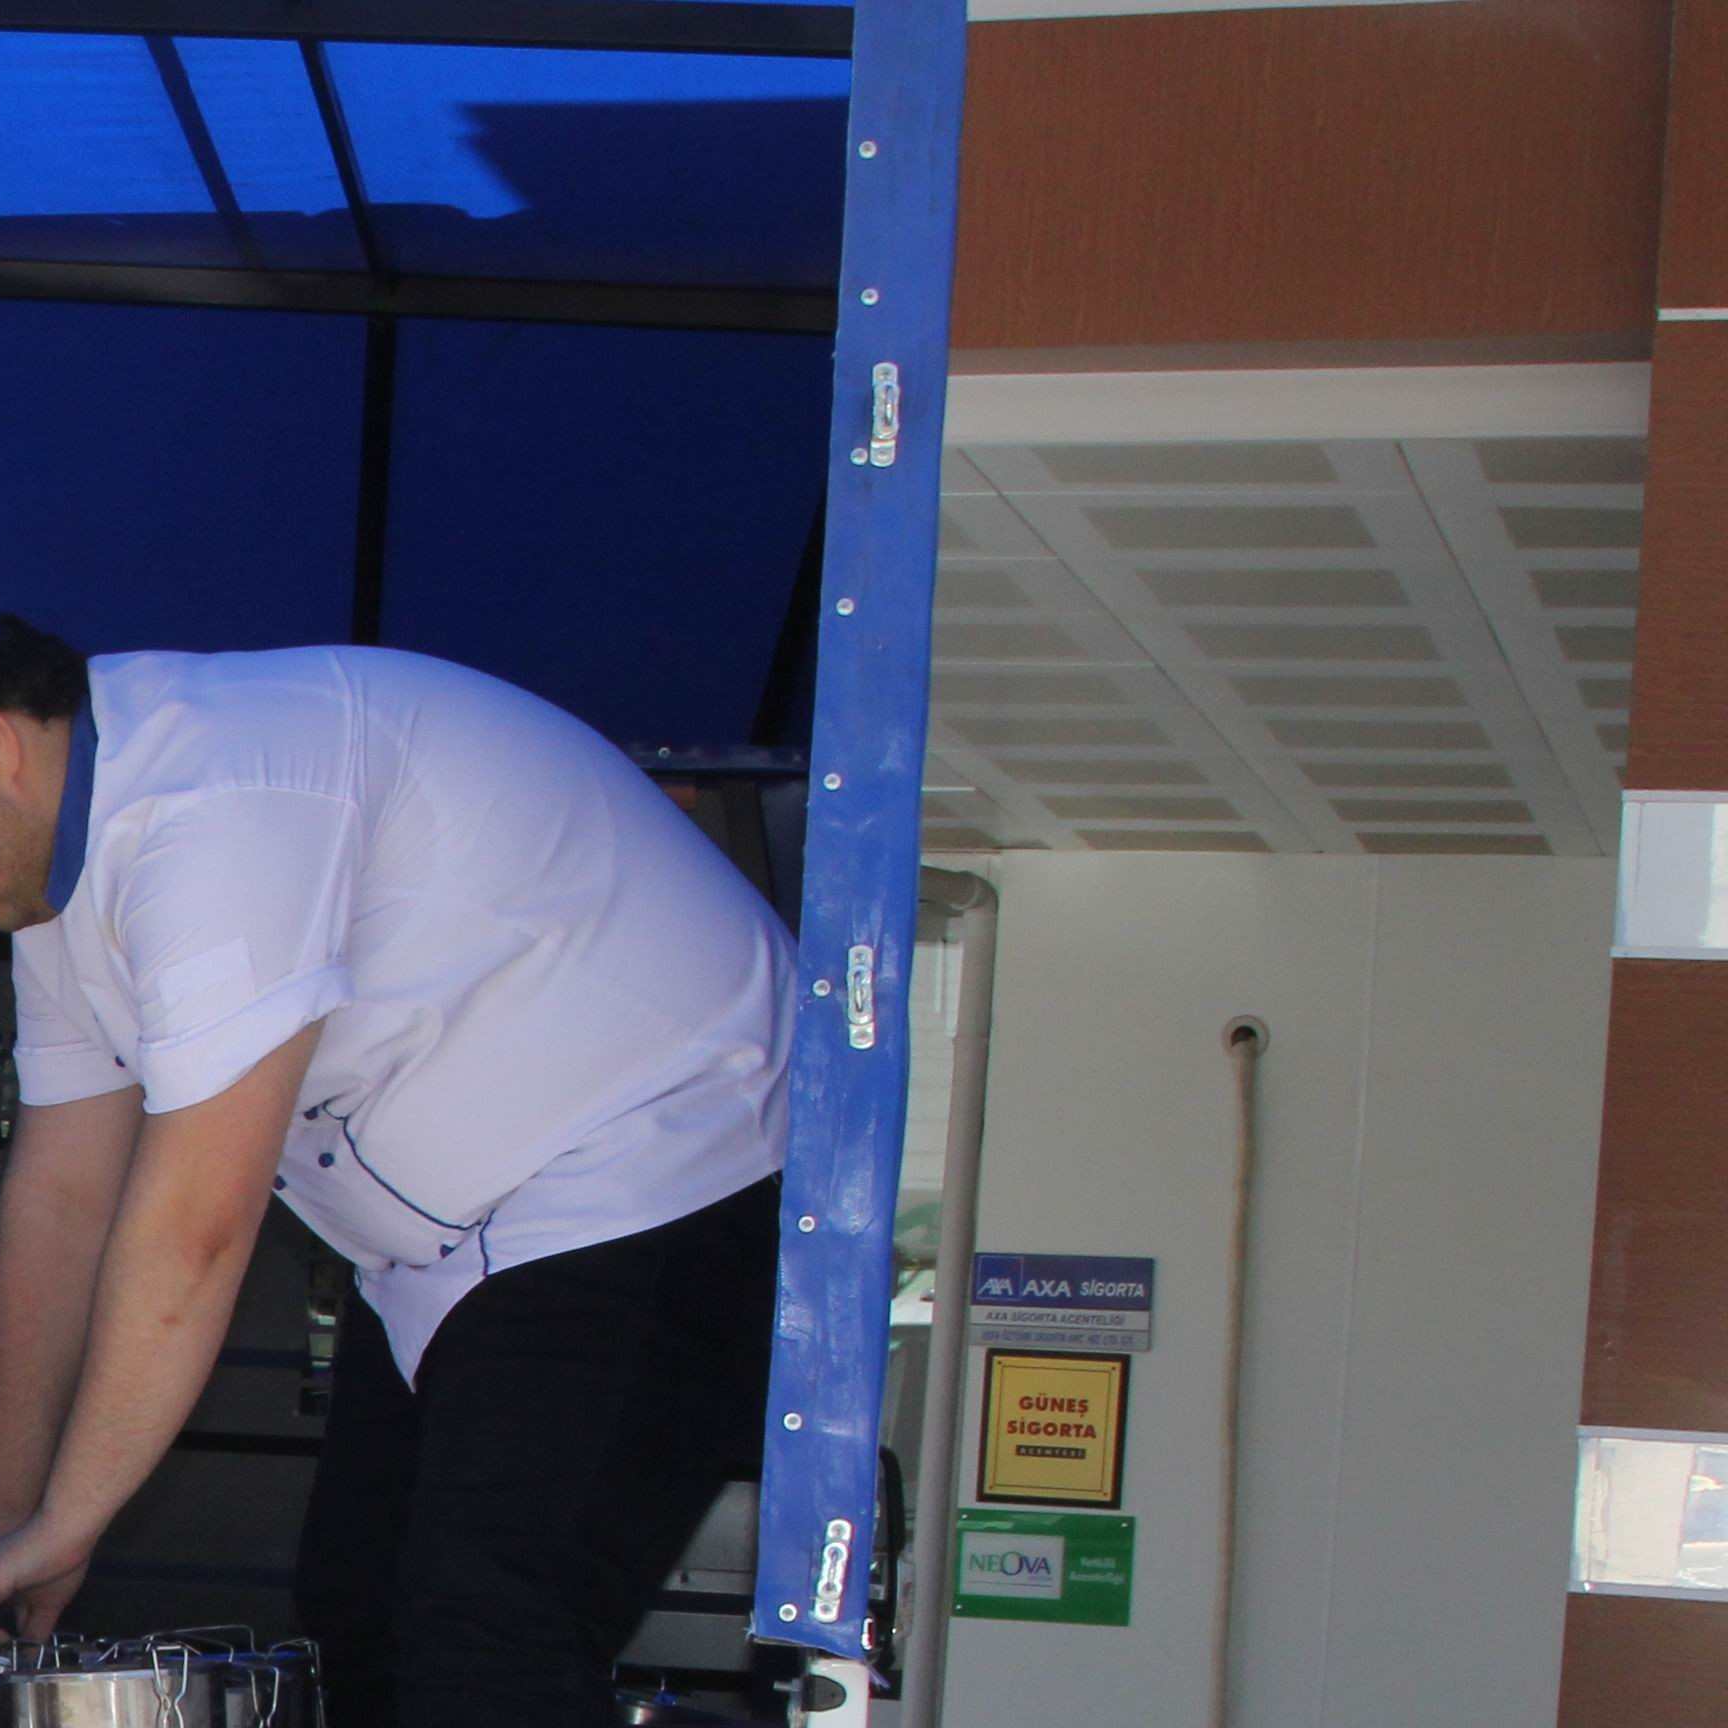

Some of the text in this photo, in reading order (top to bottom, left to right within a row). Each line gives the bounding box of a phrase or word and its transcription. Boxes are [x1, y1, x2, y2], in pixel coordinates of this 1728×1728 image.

[1023, 1278, 1145, 1298] AXA SİGORTA
[986, 1311, 1008, 1321] AXA
[1019, 1392, 1089, 1418] GÜNEŞ
[1007, 1416, 1097, 1439] SİGORTA
[968, 1551, 1052, 1576] NEOVA
